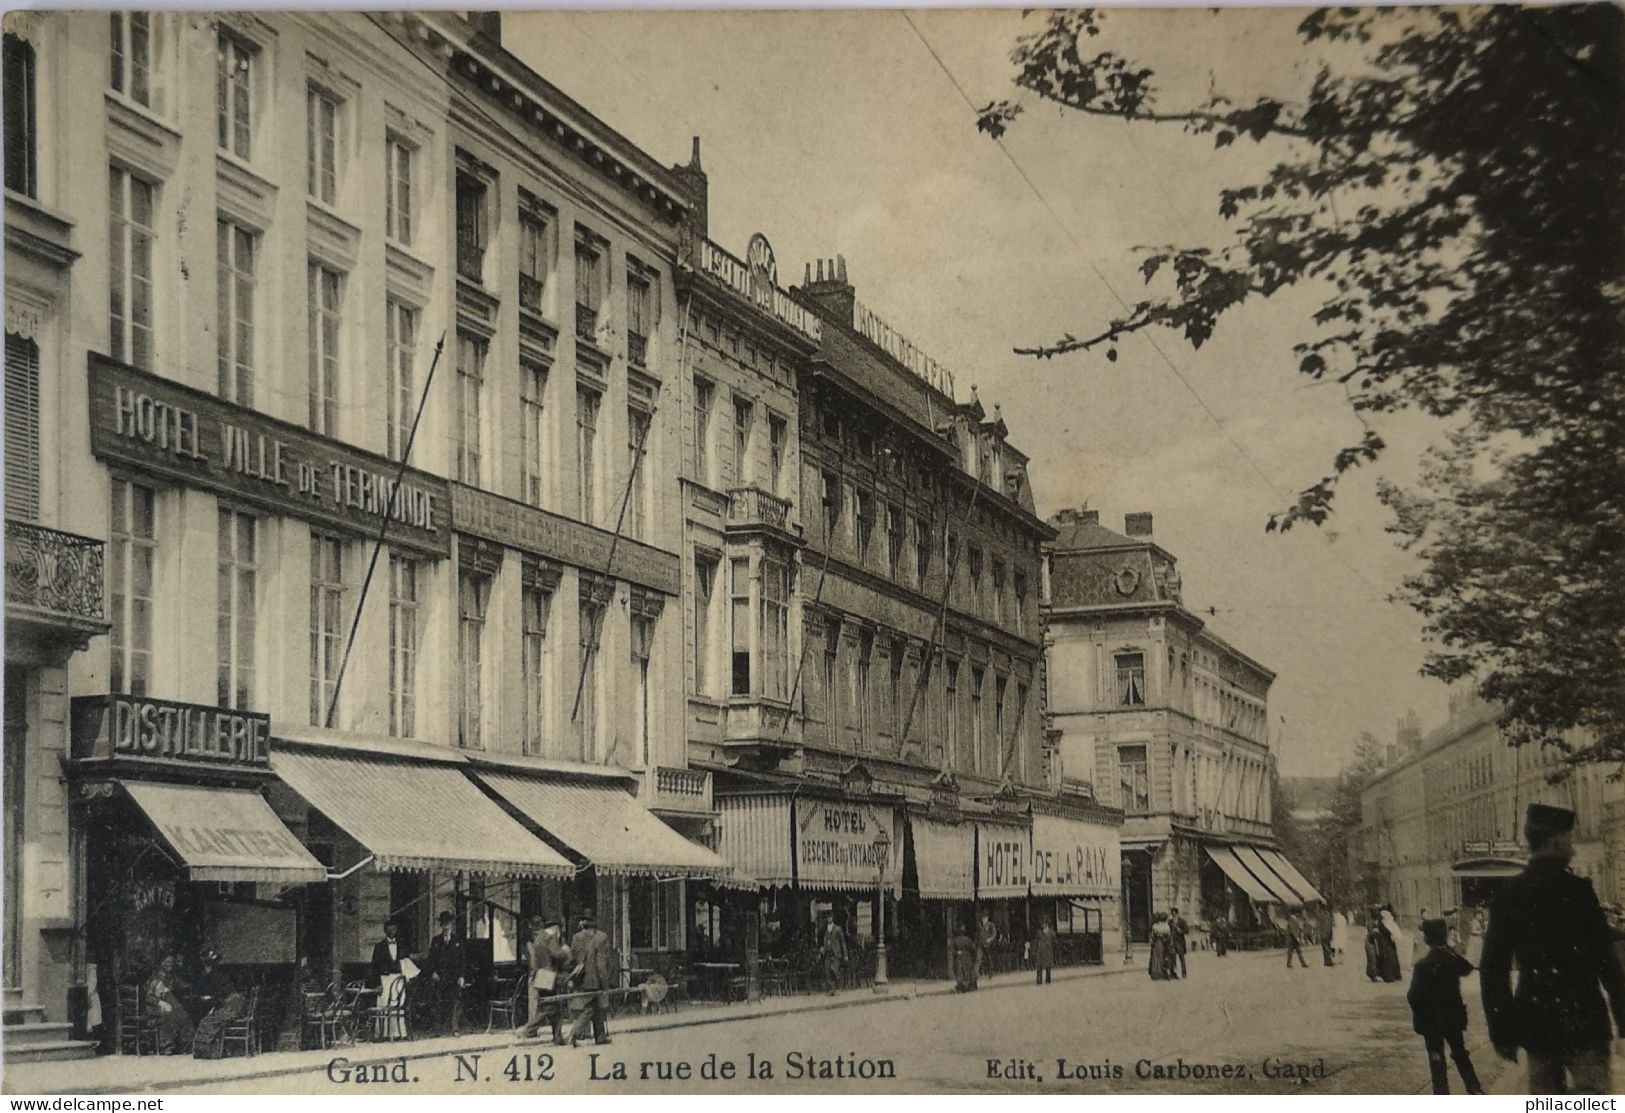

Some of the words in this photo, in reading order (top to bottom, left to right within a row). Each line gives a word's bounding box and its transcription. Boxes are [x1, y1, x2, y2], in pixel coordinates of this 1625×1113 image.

[115, 386, 208, 460] HOTEL
[220, 422, 288, 485] VILLE
[299, 463, 321, 496] DE
[329, 460, 438, 531] TERMONDE
[115, 700, 268, 763] DISTILLERIE
[824, 808, 866, 834] HOTEL
[802, 840, 839, 865] DESCENTE
[987, 841, 1026, 886] HOTEL
[1035, 850, 1052, 884] DE
[1057, 851, 1073, 885] LA
